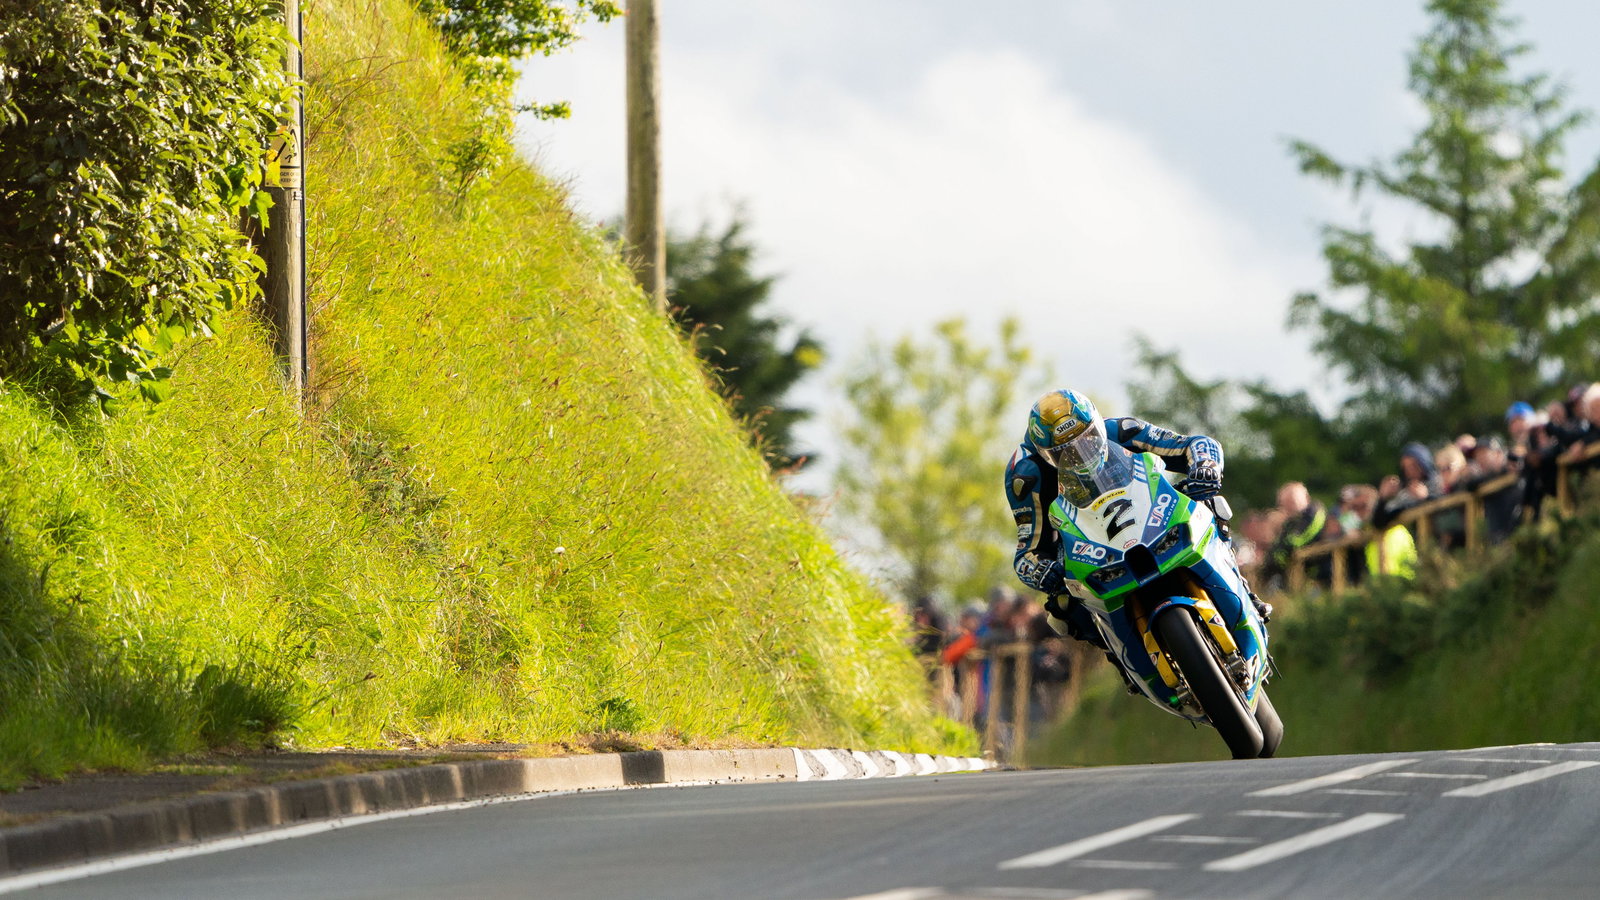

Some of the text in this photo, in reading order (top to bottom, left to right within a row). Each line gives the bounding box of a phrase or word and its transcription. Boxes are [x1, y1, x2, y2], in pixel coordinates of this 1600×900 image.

[1056, 419, 1076, 434] SHOEI
[1103, 498, 1136, 542] 2
[1163, 499, 1177, 526] RACING
[1072, 540, 1107, 560] DAO
[1072, 556, 1099, 565] RACING
